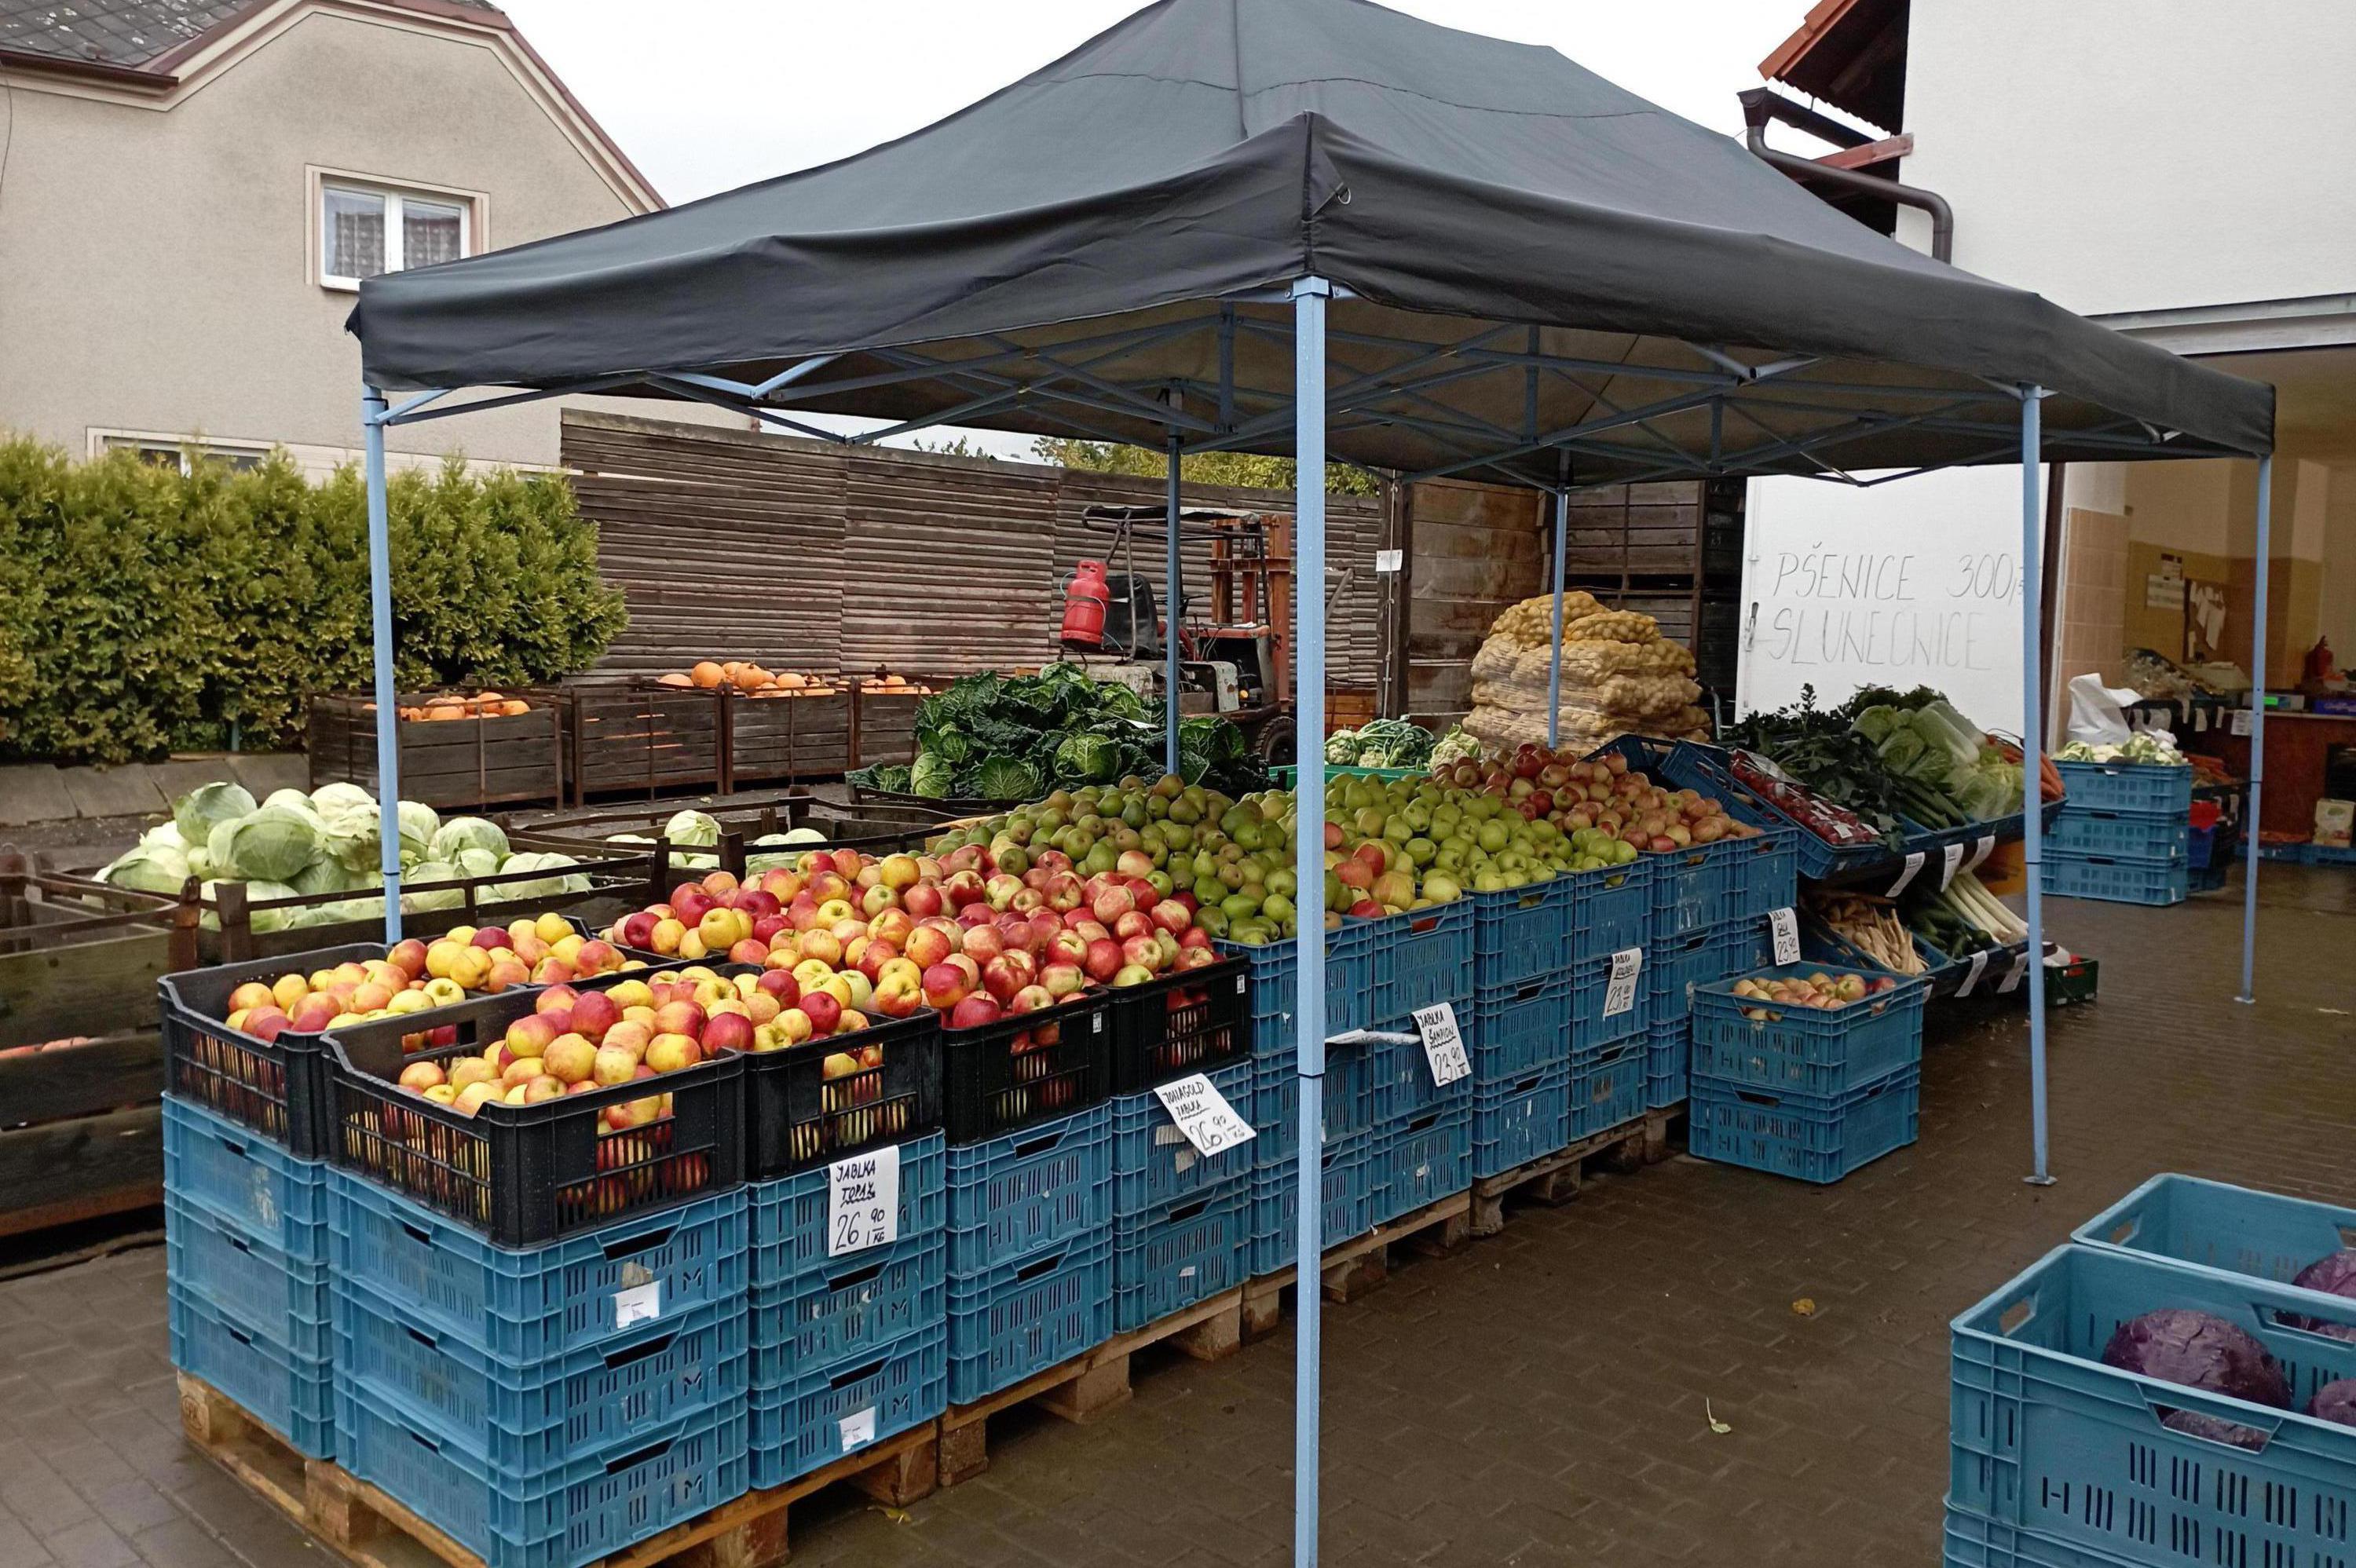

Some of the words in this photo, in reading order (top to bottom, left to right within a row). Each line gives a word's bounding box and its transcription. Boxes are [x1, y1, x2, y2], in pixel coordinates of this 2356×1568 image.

[1773, 541, 1915, 601] PŠENICE
[1417, 1009, 1445, 1029] JABLKA
[1162, 1080, 1205, 1105] JONAGOLD
[836, 1159, 876, 1182] JABLKA
